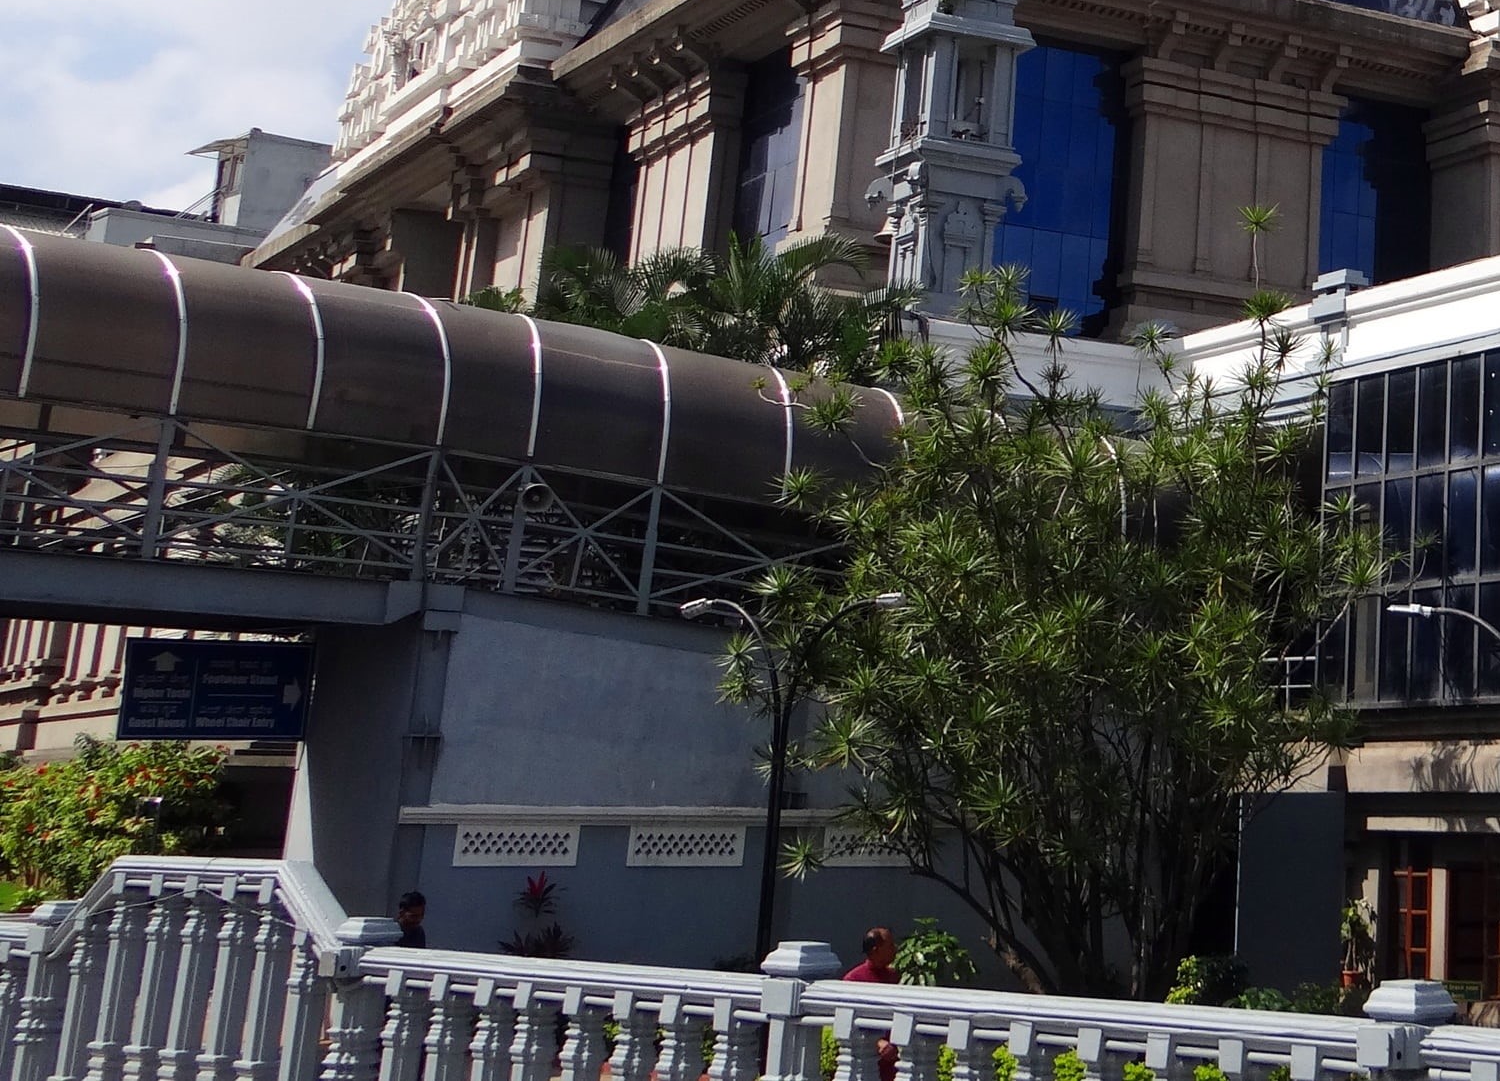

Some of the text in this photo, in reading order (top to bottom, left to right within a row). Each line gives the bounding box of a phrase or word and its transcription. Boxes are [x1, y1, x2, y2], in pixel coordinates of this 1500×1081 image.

[128, 717, 155, 728] Guest
[195, 717, 225, 727] Wheel
[251, 717, 275, 729] Entry
